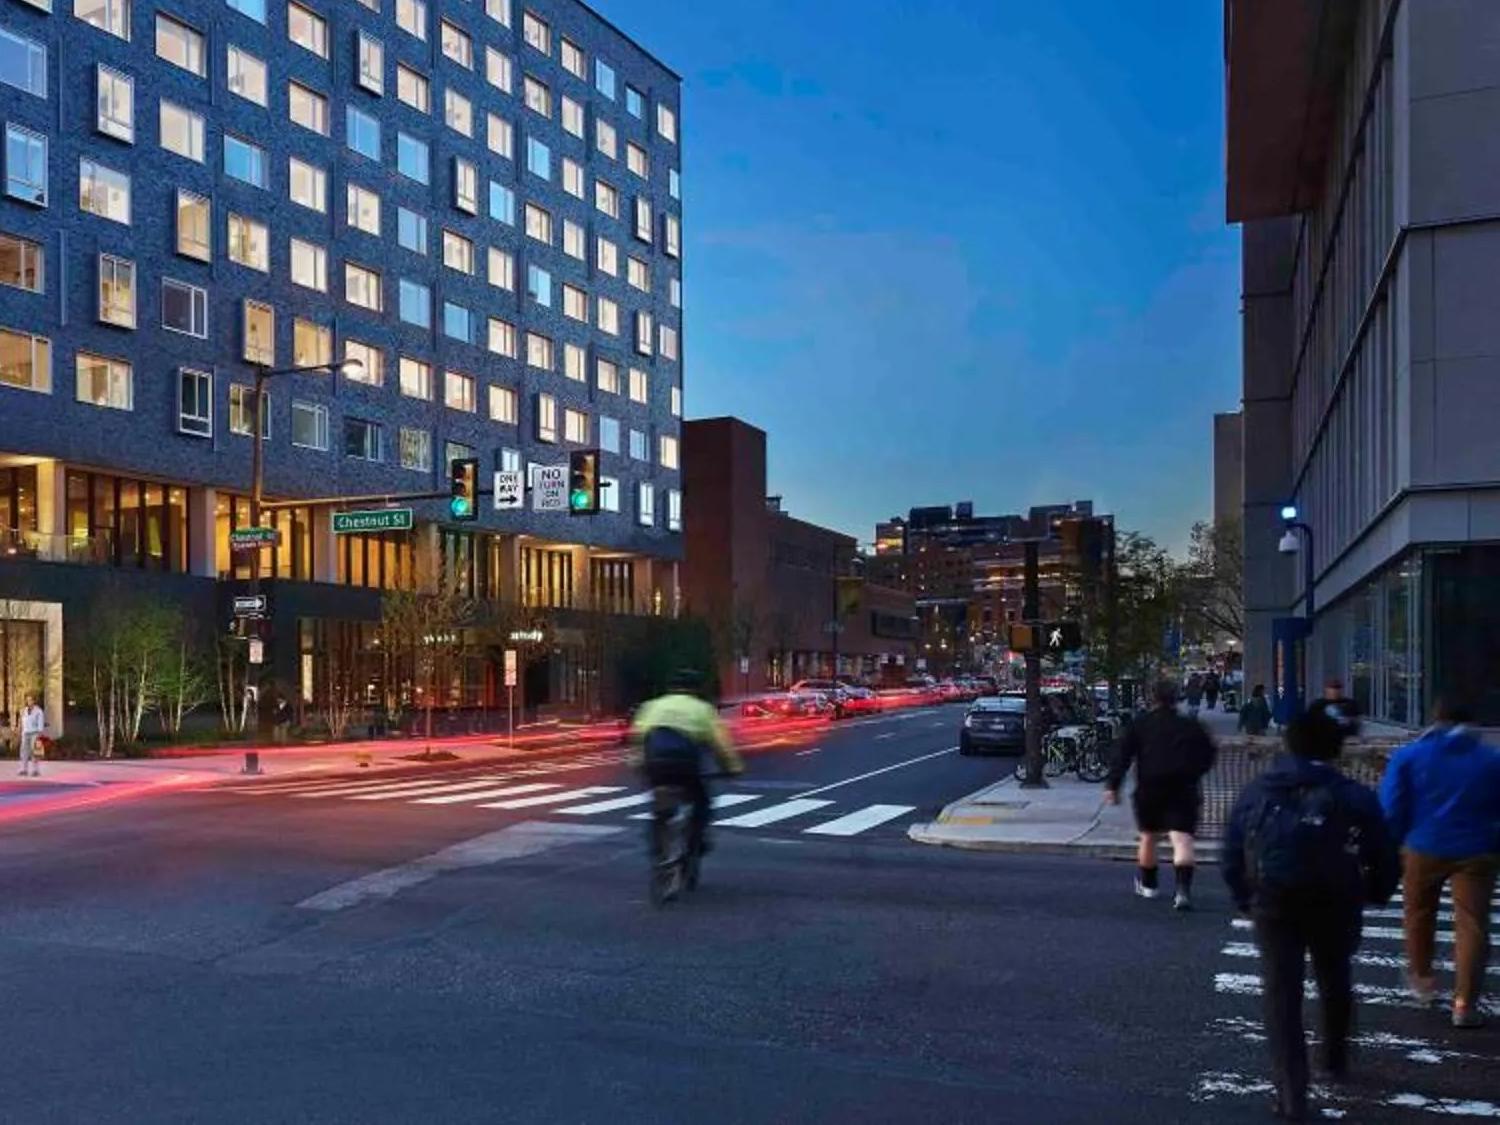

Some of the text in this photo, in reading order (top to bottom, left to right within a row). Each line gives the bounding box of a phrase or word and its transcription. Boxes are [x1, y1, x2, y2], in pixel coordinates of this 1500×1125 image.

[541, 469, 561, 479] NO
[500, 475, 517, 483] ONE
[500, 485, 518, 493] WAY
[338, 513, 406, 528] Chestnut St
